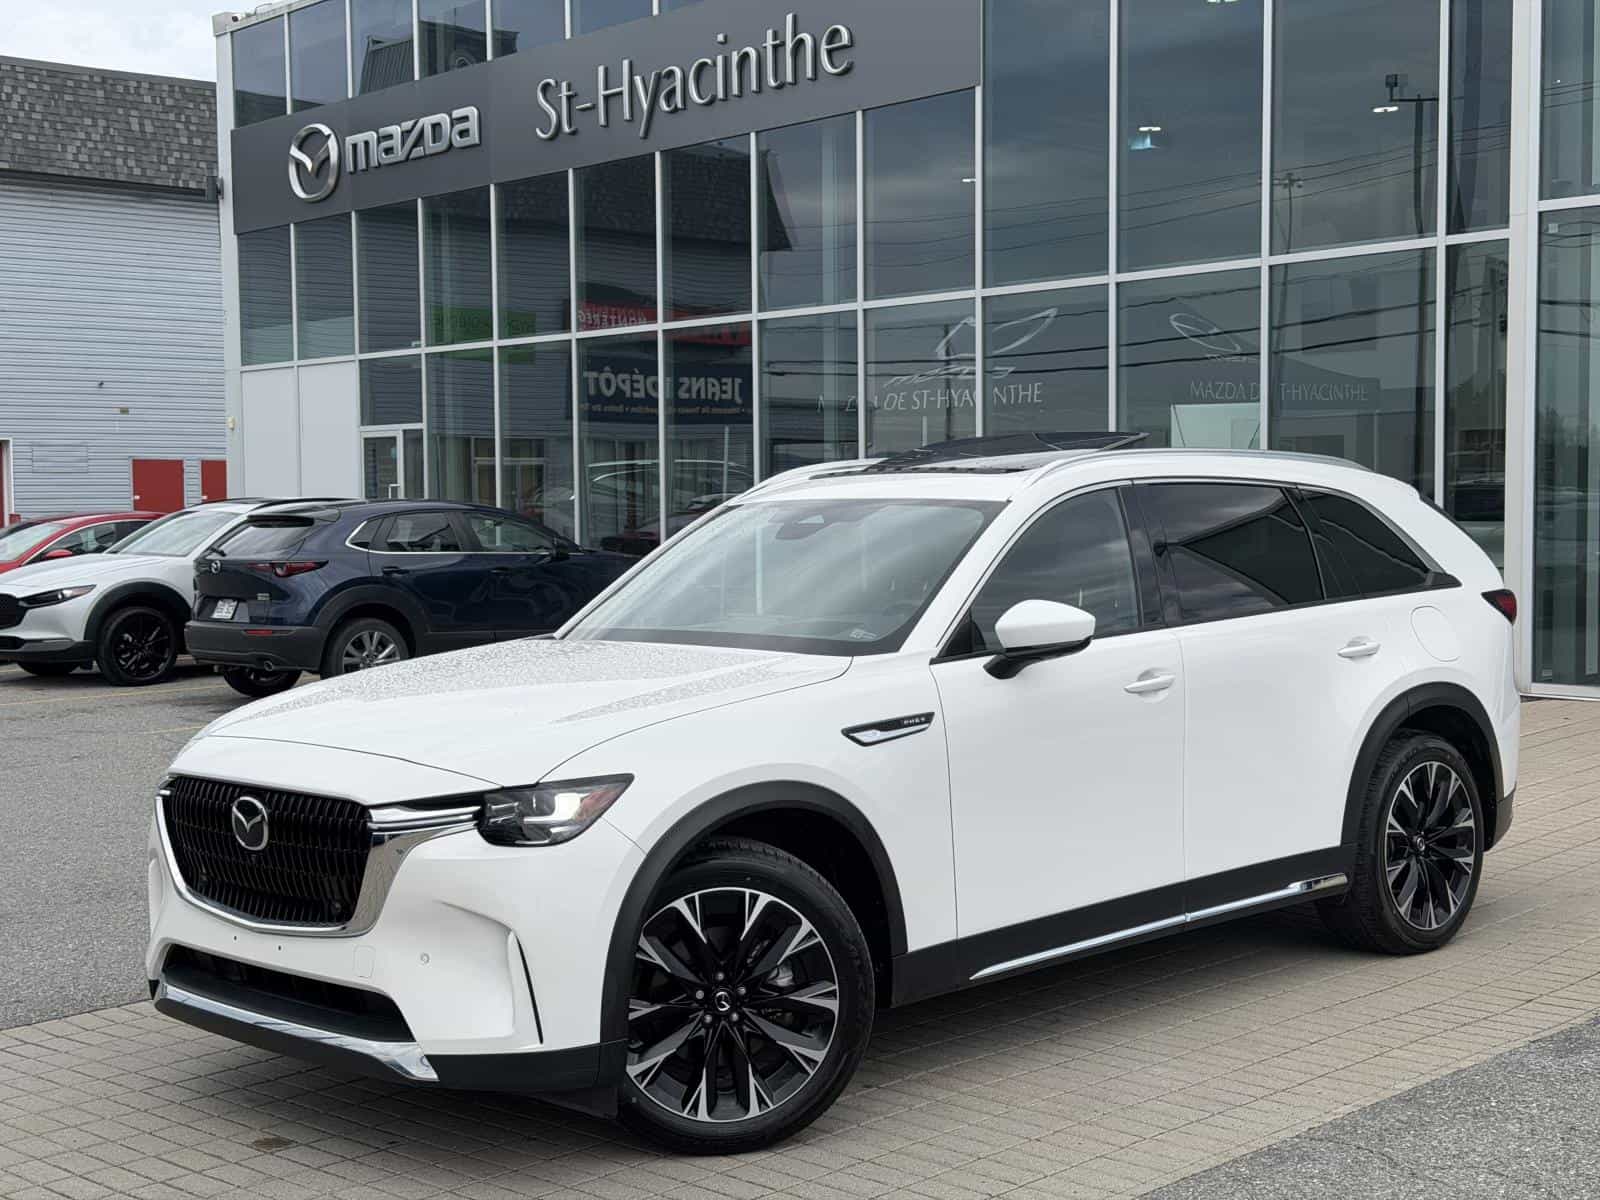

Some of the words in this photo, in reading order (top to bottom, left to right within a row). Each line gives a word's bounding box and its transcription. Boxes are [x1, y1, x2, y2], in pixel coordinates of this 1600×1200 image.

[535, 12, 853, 140] St-Hyacinthe
[344, 105, 480, 173] mazda
[1190, 381, 1247, 400] MAZDA
[1280, 383, 1368, 401] T-HYACINTHE
